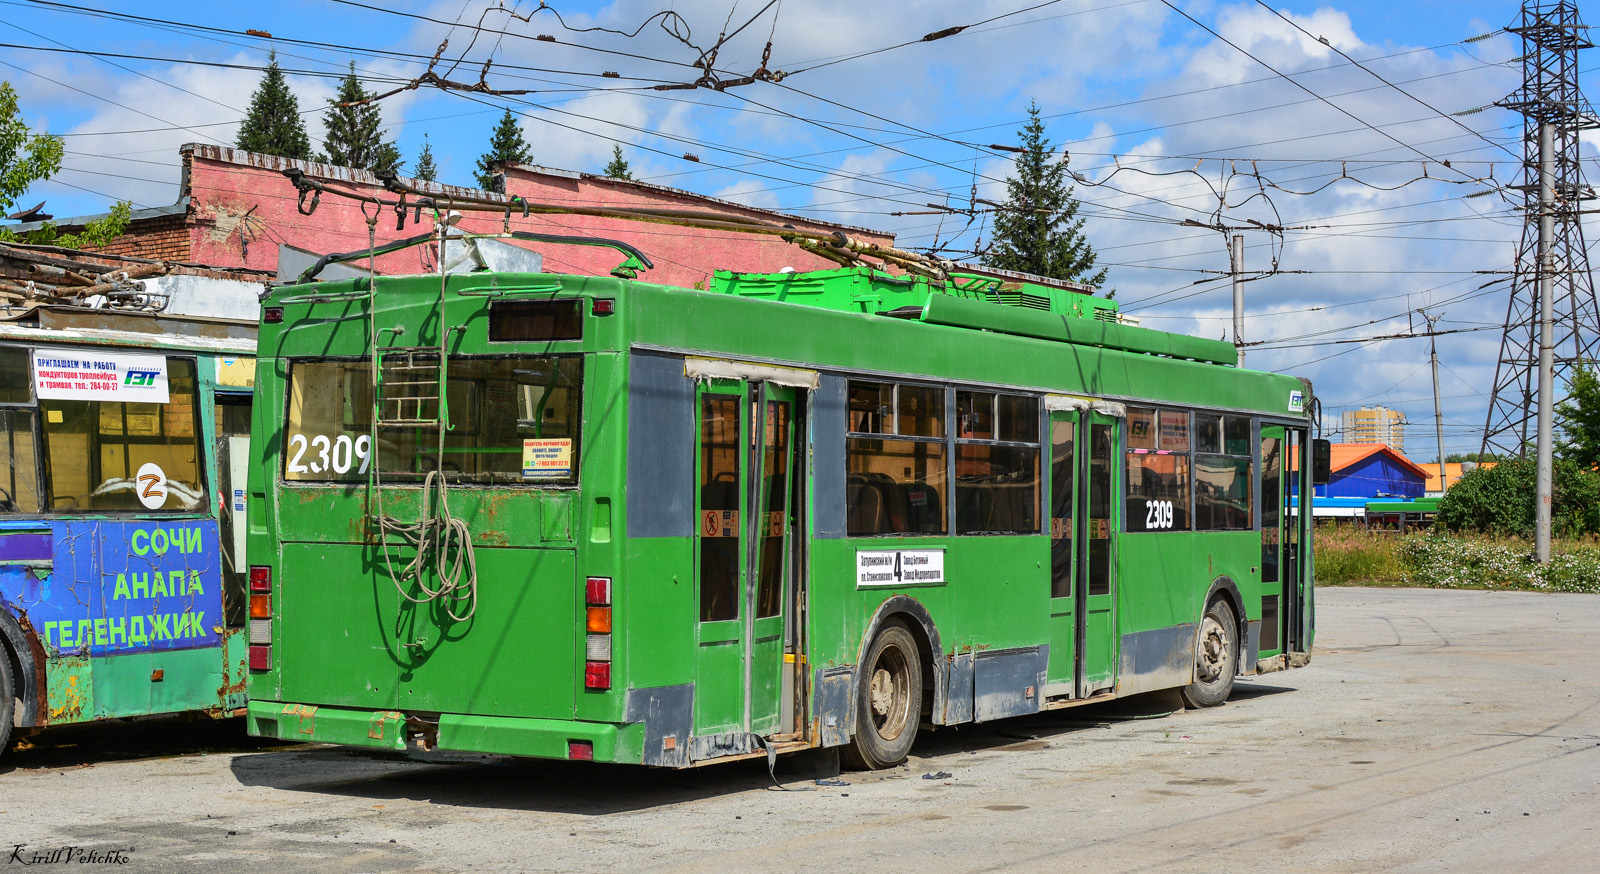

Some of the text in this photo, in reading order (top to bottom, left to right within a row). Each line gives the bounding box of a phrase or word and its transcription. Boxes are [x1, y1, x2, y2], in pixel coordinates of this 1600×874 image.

[38, 359, 116, 370] ПРИГЛАШАЕМ НА РАБОТУ
[38, 370, 117, 381] кондукторов троллейбуса
[90, 382, 118, 391] 284-00-27
[288, 434, 371, 475] 2309
[1146, 500, 1173, 528] 2309
[131, 527, 203, 556] СОЧИ
[894, 552, 902, 582] 4
[113, 570, 204, 600] АНАПА
[44, 611, 207, 648] ГЕЛЕНДЖИК
